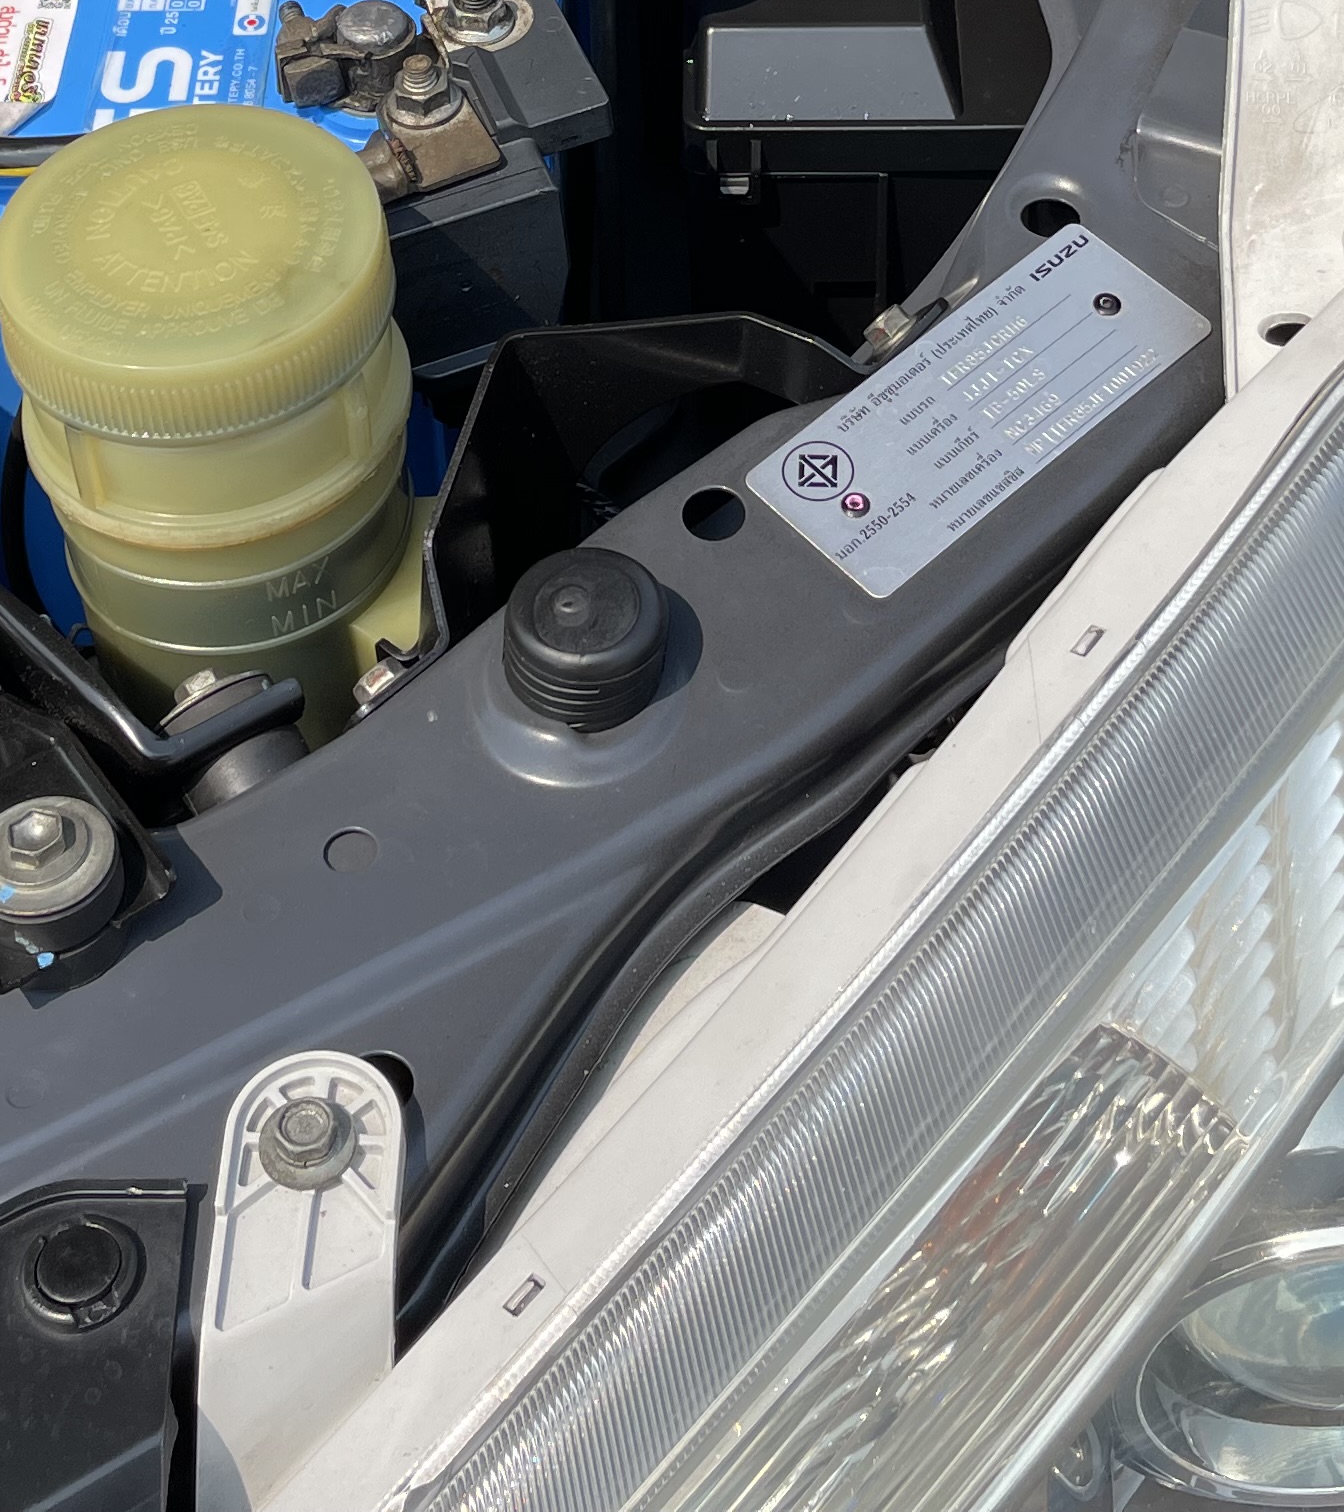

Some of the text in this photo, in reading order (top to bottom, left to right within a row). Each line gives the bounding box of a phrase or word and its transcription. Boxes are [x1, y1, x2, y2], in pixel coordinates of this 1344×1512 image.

[85, 157, 184, 241] CAUTION
[93, 250, 261, 294] ATTENTION
[1028, 229, 1090, 285] ISUZU
[833, 400, 873, 437] บริษัท
[927, 298, 1000, 364] (ประเทศไทย)
[992, 278, 1027, 311] จำกัด
[896, 391, 937, 428] แบบรถ
[901, 406, 959, 459] แบบเครื่อง
[929, 425, 981, 472] แบบเกียร์
[923, 440, 1005, 513] หมายเลขเครื่อง
[833, 489, 918, 562] มอก.2550-2554
[265, 555, 329, 602] MAX
[271, 589, 336, 636] MIN
